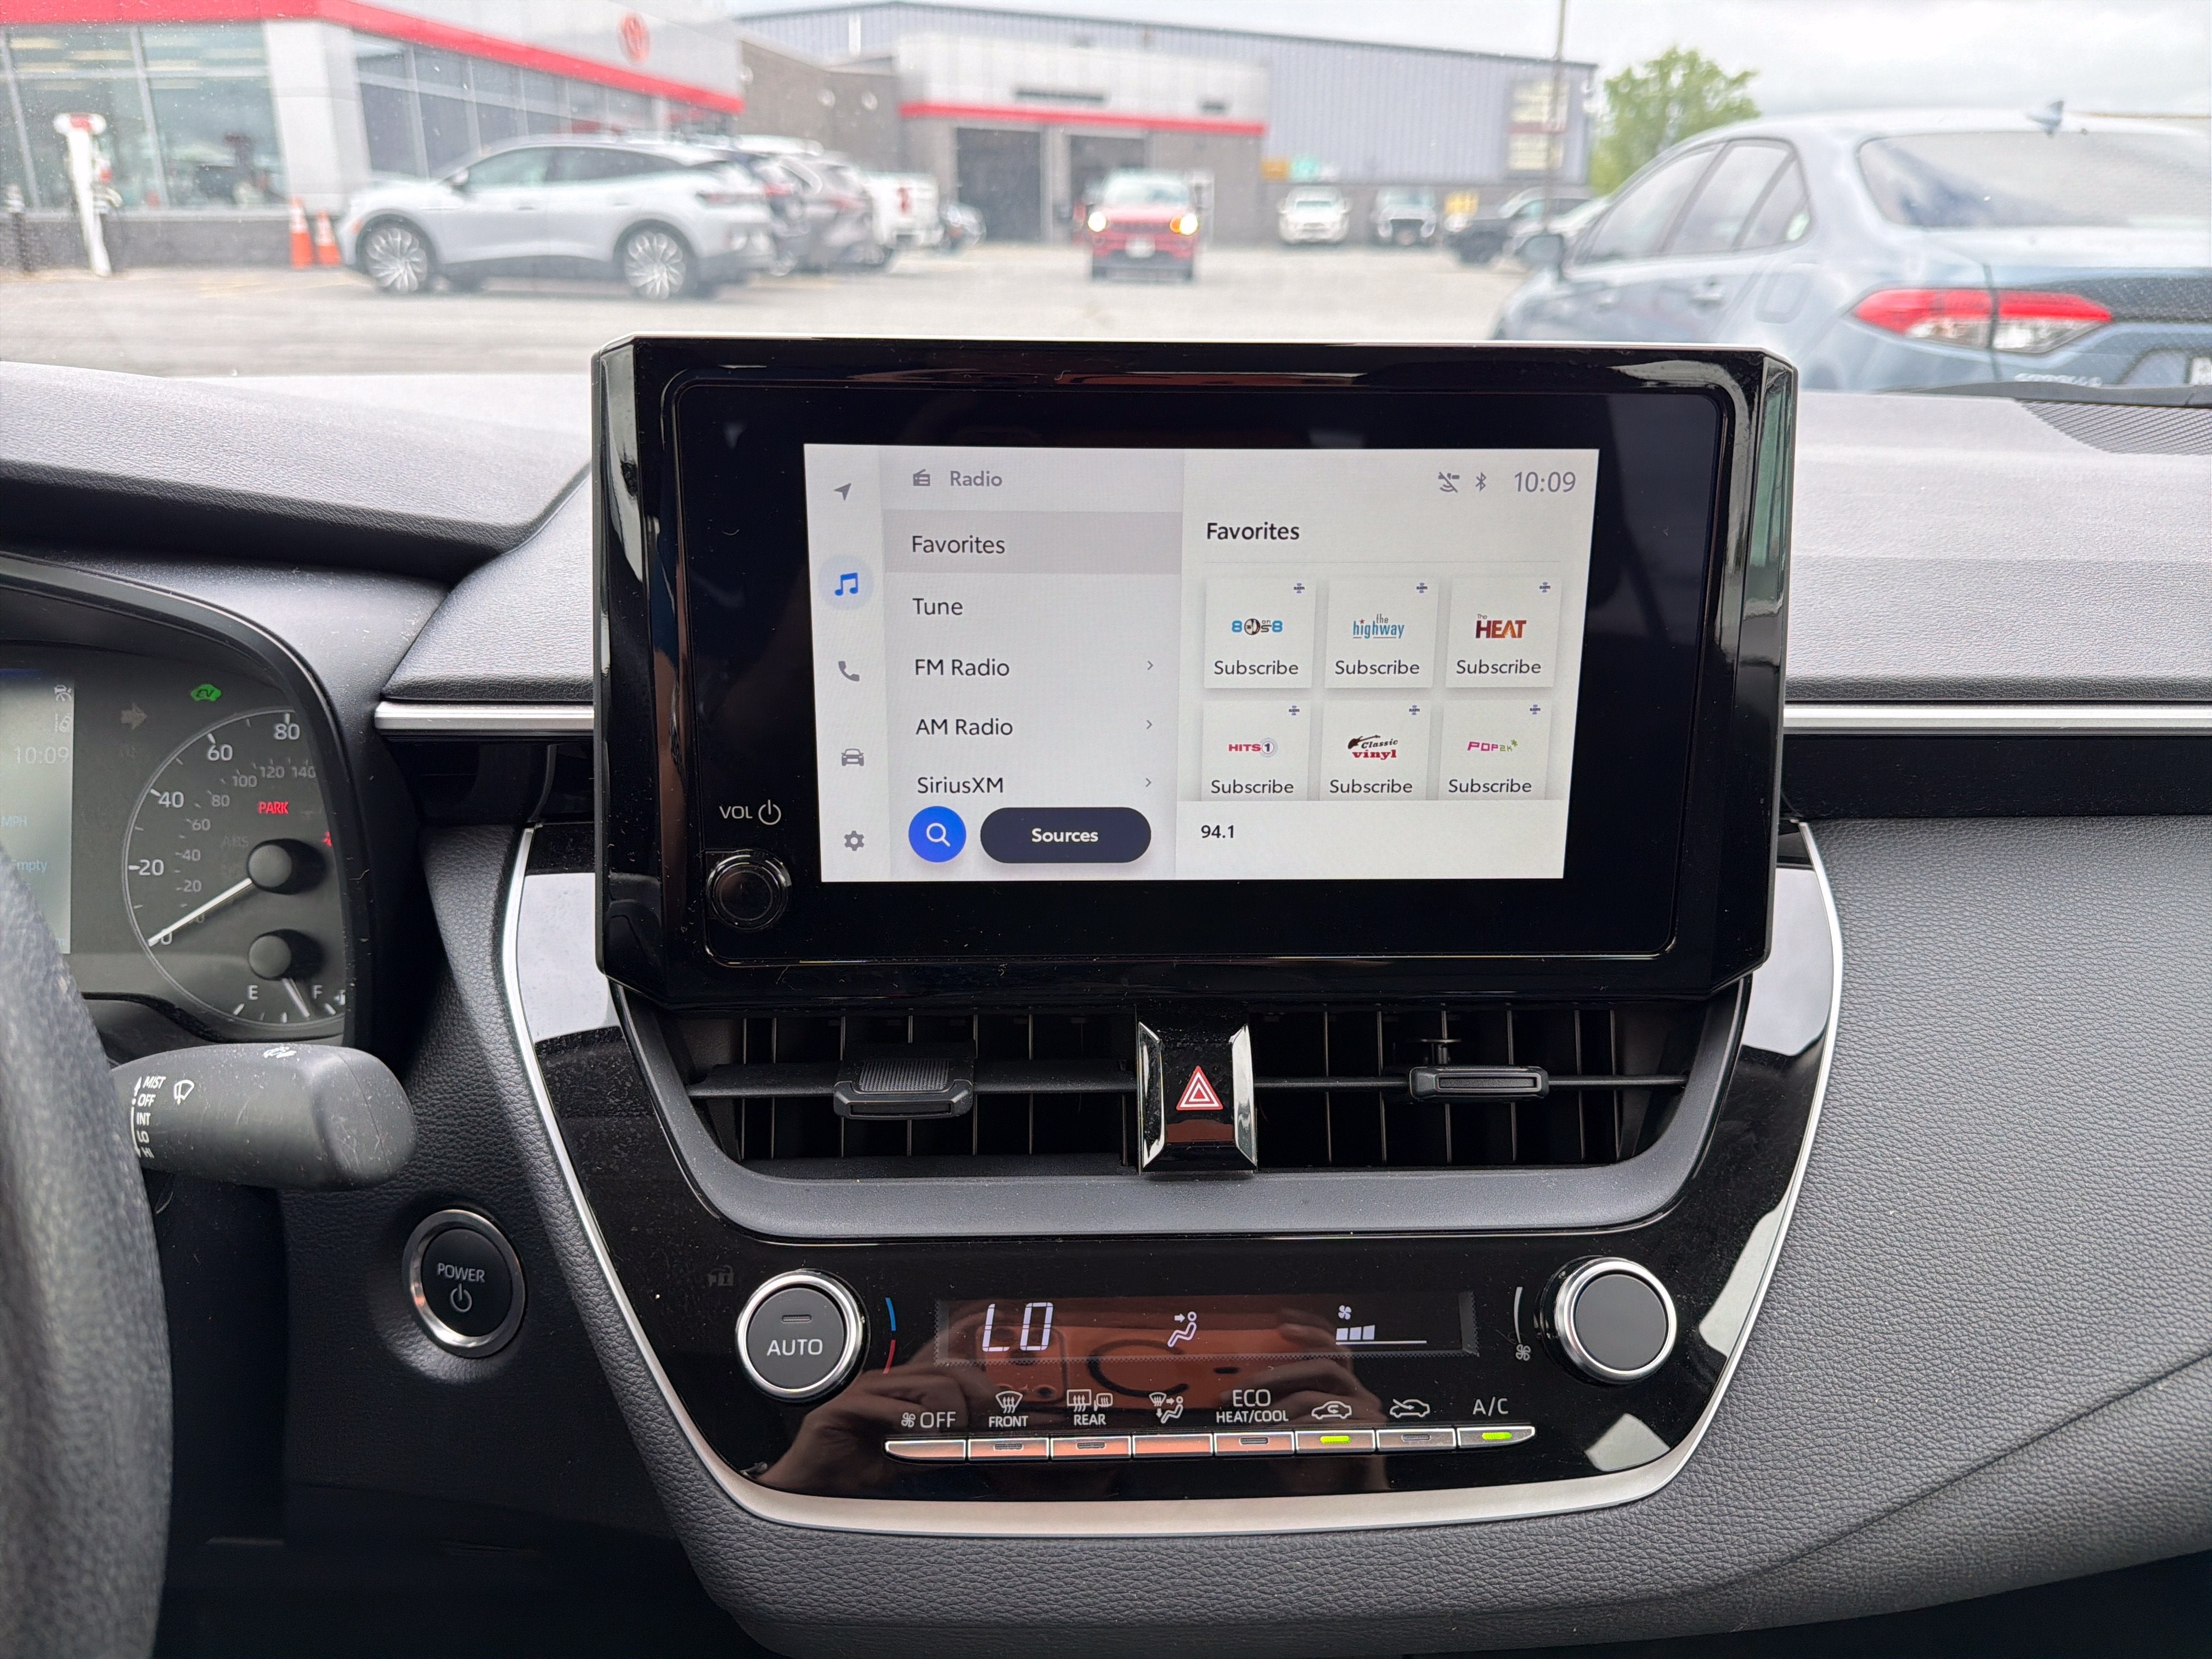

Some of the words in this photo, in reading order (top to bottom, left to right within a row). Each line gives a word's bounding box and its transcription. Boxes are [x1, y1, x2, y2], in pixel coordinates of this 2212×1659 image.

[951, 471, 1002, 486] Radio
[1515, 472, 1576, 492] 10:09
[1207, 522, 1299, 540] Favorites
[913, 535, 1005, 554] Favorites
[912, 598, 963, 615] Tune
[1376, 613, 1389, 624] the
[1353, 619, 1404, 639] highway
[1476, 620, 1527, 639] HEAT
[916, 659, 943, 675] FM
[952, 658, 1009, 676] Radio
[1215, 660, 1298, 674] Subscribe
[1335, 660, 1419, 674] Subscribe
[1457, 659, 1541, 674] Subscribe
[275, 723, 300, 740] 80
[916, 719, 947, 735] AM
[956, 718, 1013, 735] Radio
[1361, 738, 1398, 749] Classic
[15, 747, 69, 764] 10:09
[207, 744, 233, 761] 60
[1352, 749, 1397, 760] vinyl
[260, 766, 285, 778] 120
[291, 766, 316, 778] 140
[233, 775, 257, 787] 100
[918, 777, 1003, 793] SiriusXM
[1211, 780, 1294, 793] Subscribe
[1330, 779, 1412, 793] Subscribe
[1449, 778, 1531, 792] Subscribe
[159, 792, 184, 808] 40
[211, 794, 230, 807] 80
[258, 801, 289, 814] PARK
[719, 806, 753, 819] VOL
[2, 816, 27, 827] MPH
[192, 818, 211, 831] 60
[1032, 828, 1098, 842] Sources
[1201, 825, 1233, 838] 94.1
[183, 849, 201, 861] 40
[11, 859, 48, 873] mpty
[139, 859, 164, 876] 20
[183, 879, 202, 893] 20
[248, 985, 258, 1000] E
[313, 985, 323, 1000] F
[143, 1076, 167, 1089] MIST
[137, 1093, 156, 1107] OFF
[137, 1112, 151, 1126] INT
[137, 1130, 150, 1143] LO
[141, 1147, 155, 1159] HI
[437, 1262, 486, 1283] POWER
[982, 1302, 1053, 1352] LO
[766, 1339, 823, 1356] AUTO
[1232, 1389, 1271, 1407] ECO
[1472, 1396, 1509, 1417] A/C
[920, 1412, 956, 1428] OFF
[989, 1415, 1029, 1427] FRONT
[1074, 1414, 1107, 1426] REAR
[1216, 1410, 1289, 1424] HEAT/COOL
